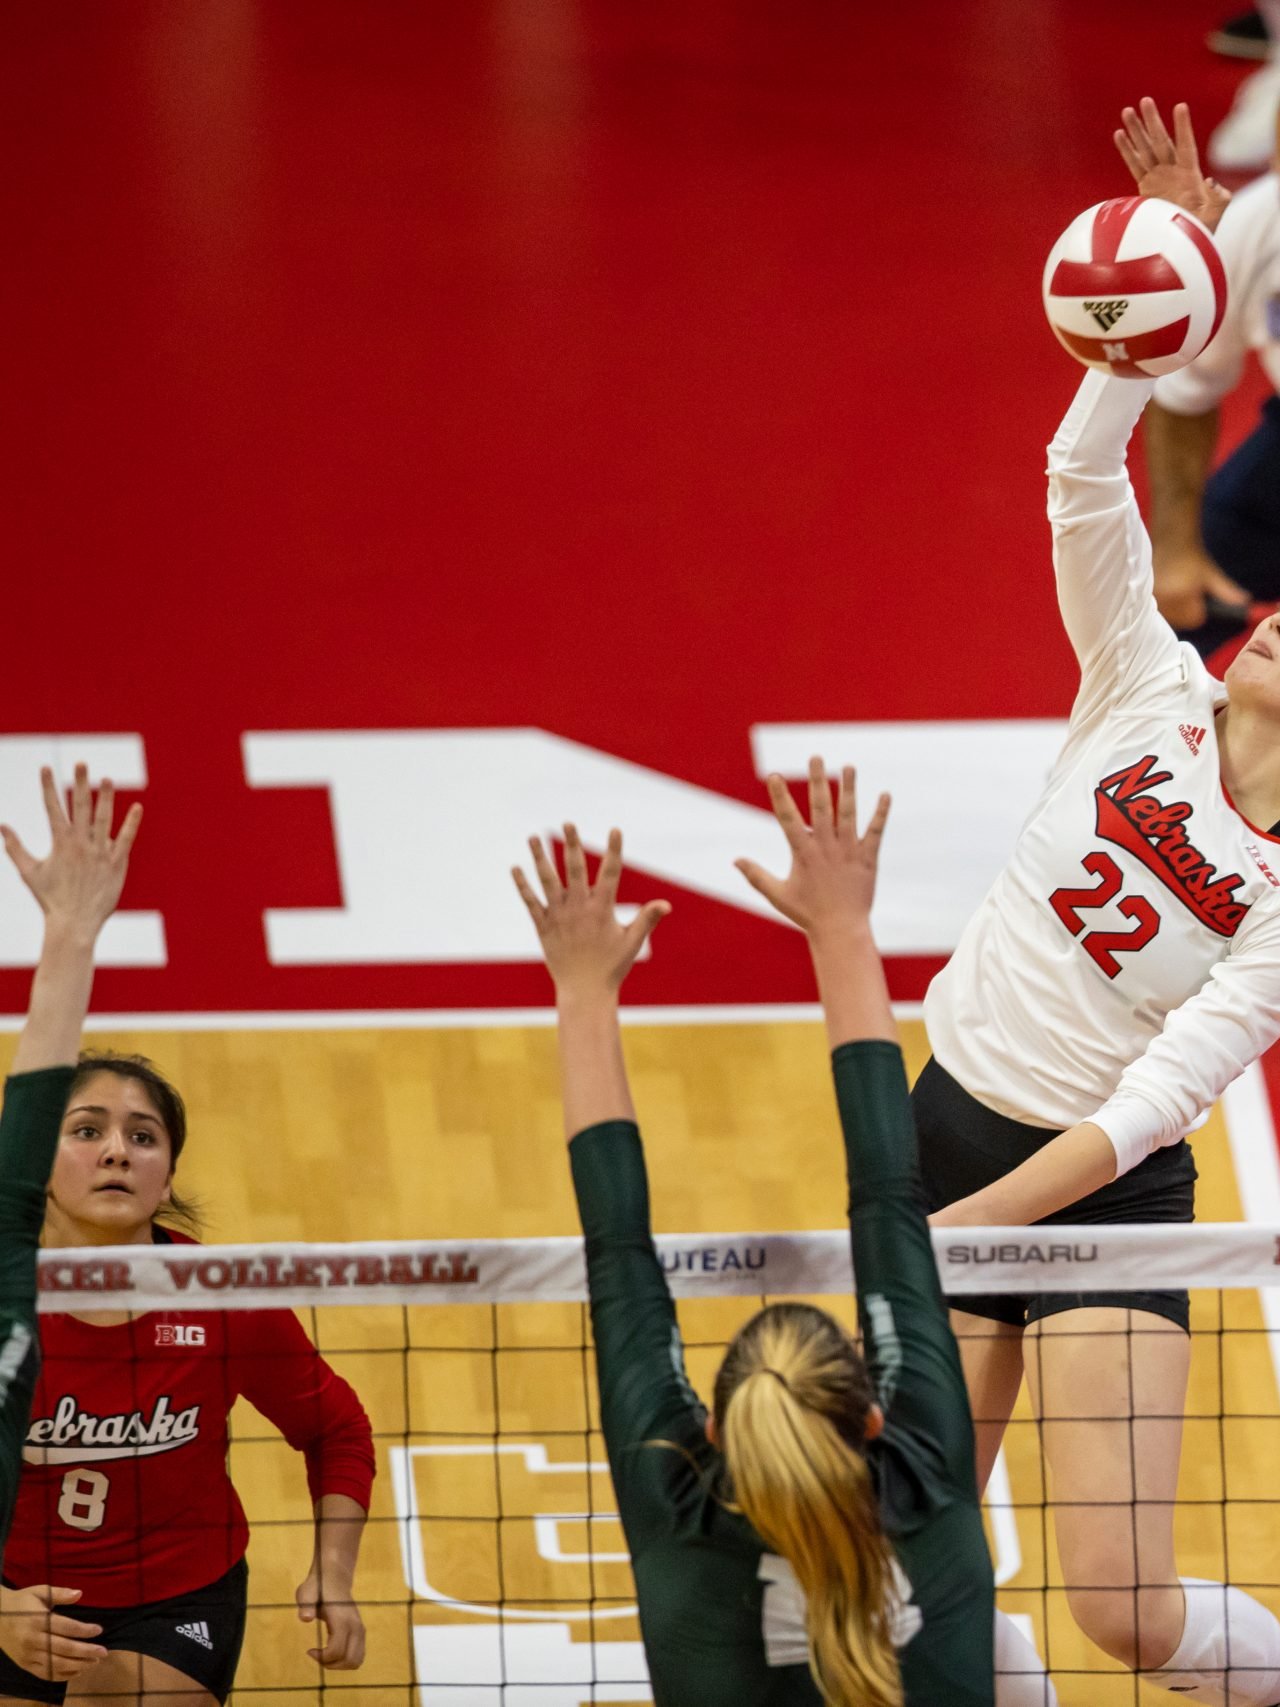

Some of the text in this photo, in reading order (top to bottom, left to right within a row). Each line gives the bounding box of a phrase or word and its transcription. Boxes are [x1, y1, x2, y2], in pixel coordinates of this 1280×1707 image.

[1178, 723, 1200, 757] adidas
[1097, 755, 1252, 931] Nebraska
[1048, 851, 1161, 980] 22
[164, 1252, 479, 1290] VOLLEYBALL
[947, 1244, 1098, 1264] SUBARU
[57, 1467, 110, 1532] 8
[175, 1625, 214, 1651] adidas
